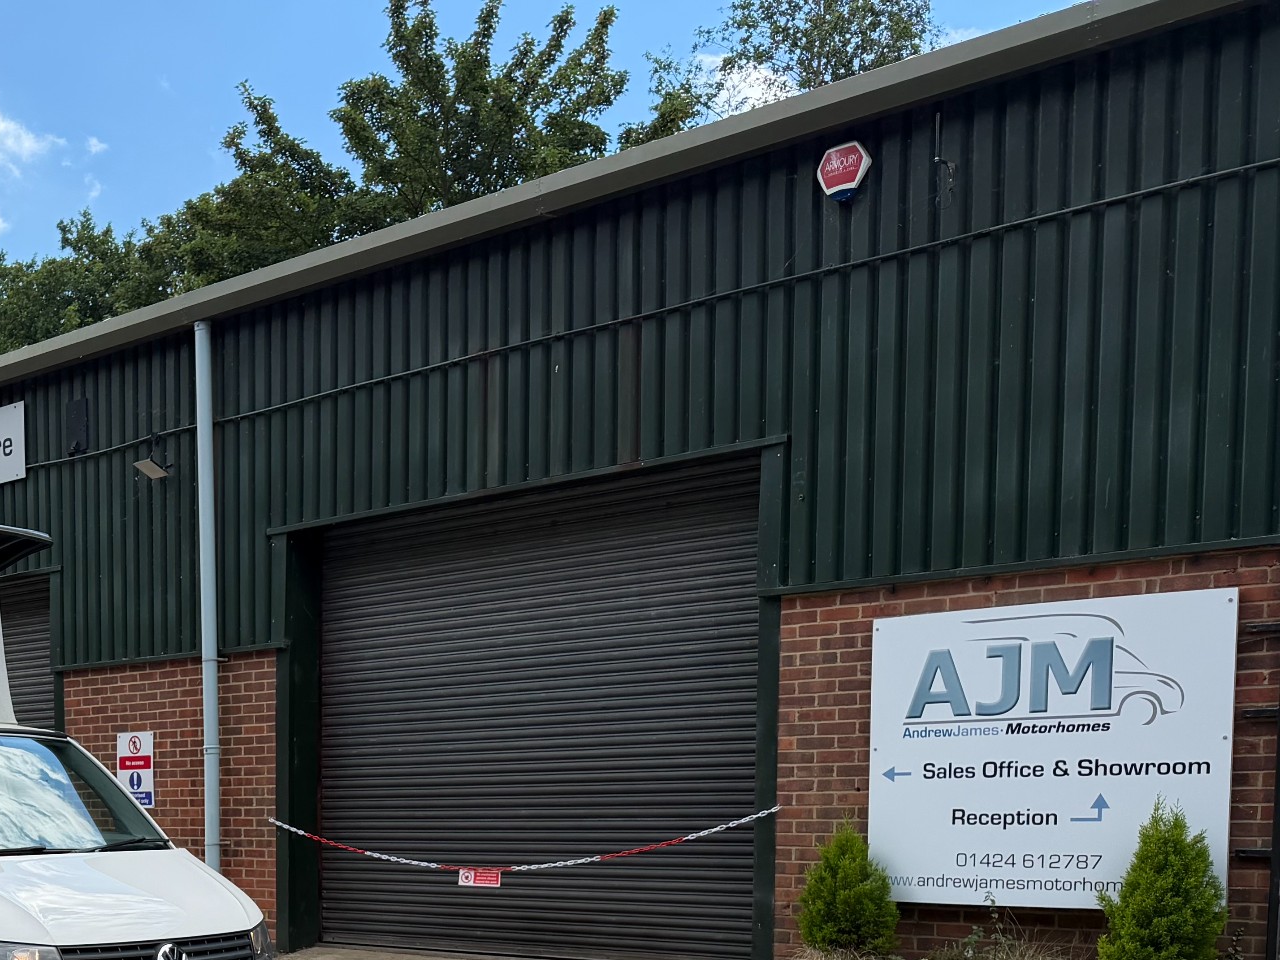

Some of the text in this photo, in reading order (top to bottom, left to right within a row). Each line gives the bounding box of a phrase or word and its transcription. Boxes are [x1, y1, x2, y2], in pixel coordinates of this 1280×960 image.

[825, 154, 858, 172] ARMOURY
[905, 636, 1114, 719] AJM
[922, 758, 1211, 780] Sales Office & Showroom
[951, 809, 1058, 829] Reception
[956, 852, 1103, 870] 01424 612787
